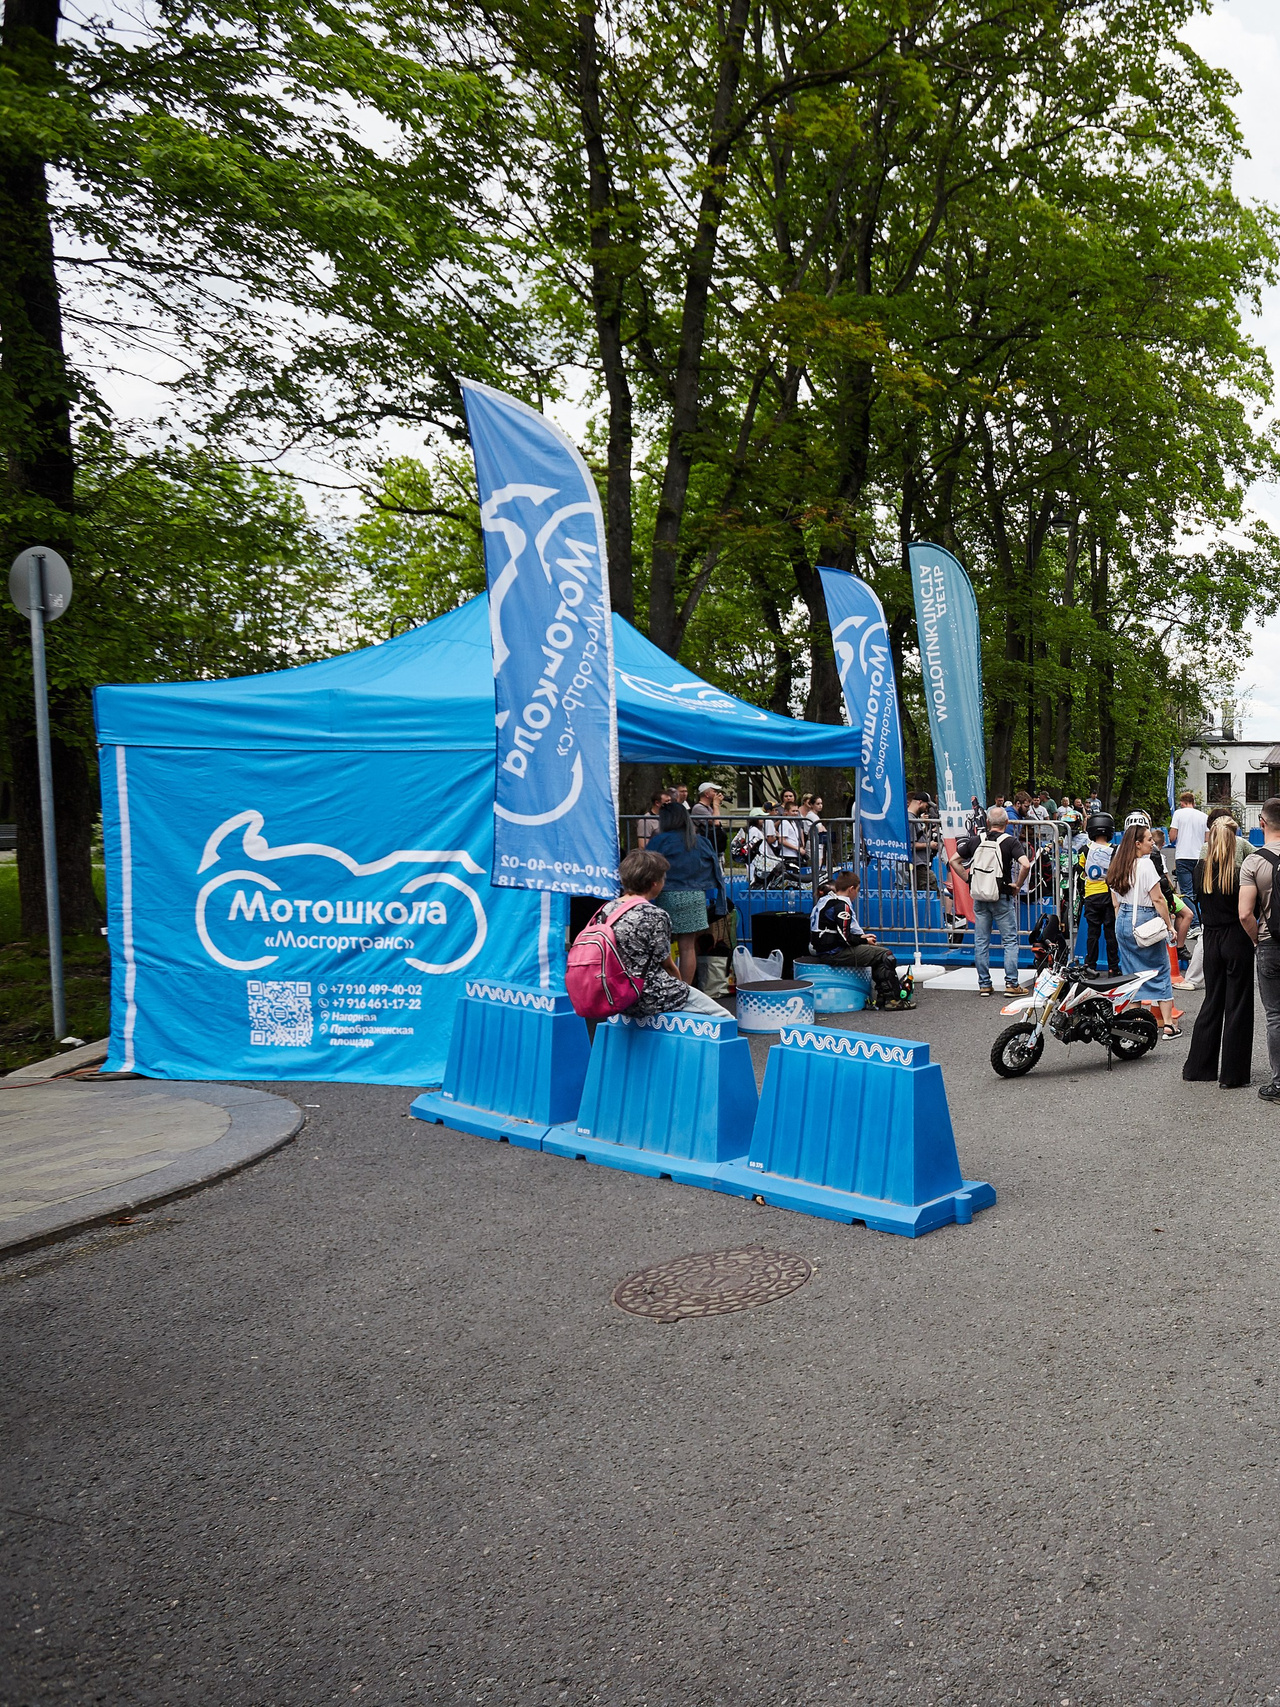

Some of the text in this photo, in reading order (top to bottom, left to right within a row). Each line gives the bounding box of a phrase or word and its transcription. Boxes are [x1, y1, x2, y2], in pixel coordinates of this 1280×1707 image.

[228, 890, 447, 924] Мотошкола
[264, 930, 415, 952] «Мосгортранс»
[330, 984, 422, 995] +7 910 499-40-02
[332, 998, 421, 1010] +7 916 461-17-22
[331, 1011, 377, 1023] Нагорная
[330, 1024, 414, 1035] Преображенская
[329, 1038, 375, 1048] площадь
